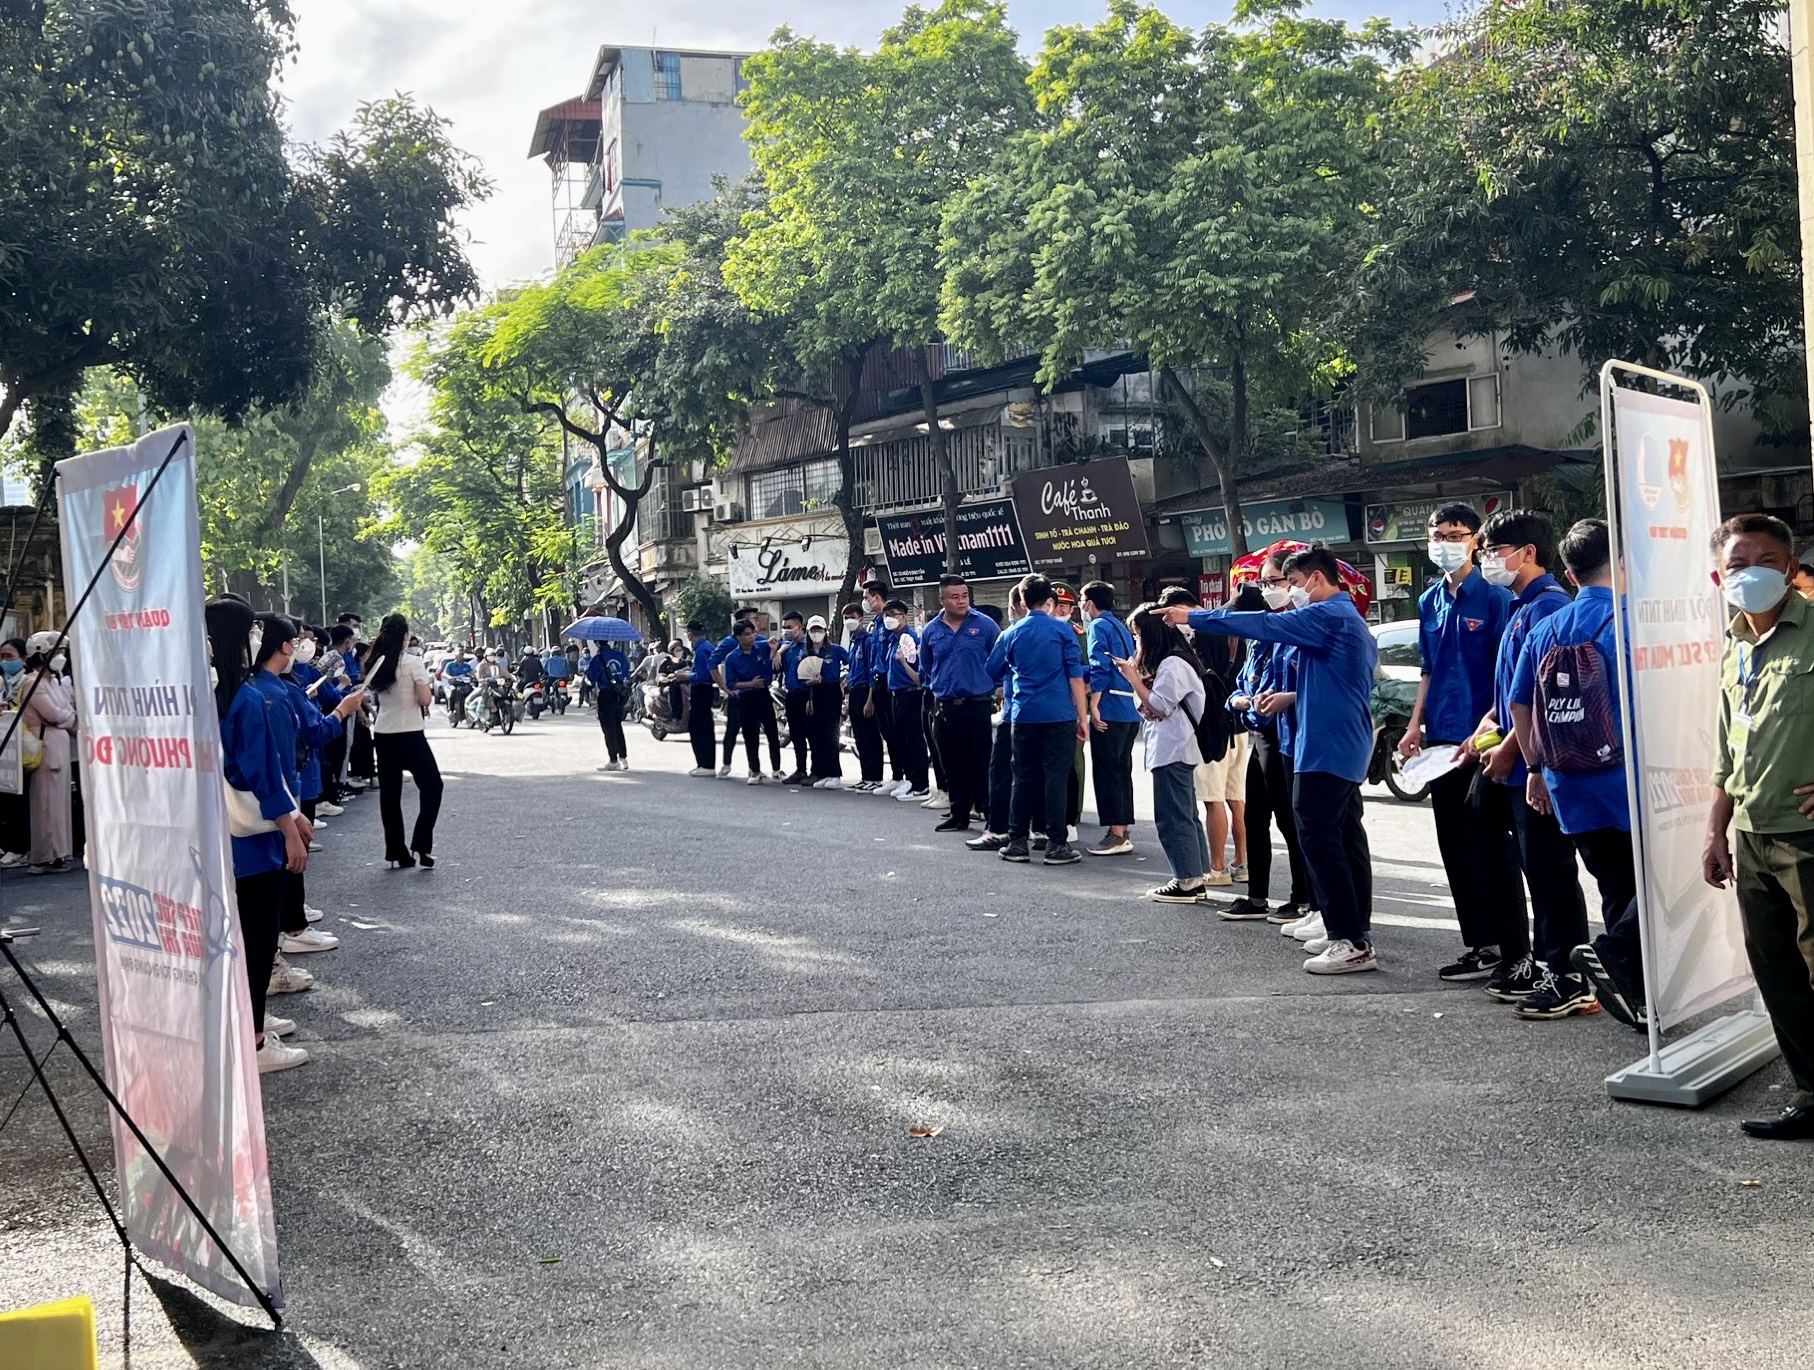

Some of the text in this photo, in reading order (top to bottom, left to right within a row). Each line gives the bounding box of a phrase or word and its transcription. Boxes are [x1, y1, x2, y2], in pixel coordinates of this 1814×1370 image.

[1041, 479, 1077, 516] Café
[1070, 502, 1112, 521] Thanh
[1191, 516, 1227, 543] PHỞ
[1298, 506, 1325, 531] BÒ
[888, 523, 1015, 558] Made in Vitnam1111
[1034, 531, 1049, 540] SINH
[1061, 526, 1074, 538] TRÀ
[1073, 525, 1097, 536] CHANH
[1100, 522, 1113, 533] TRÀ
[1071, 540, 1086, 550] HOA
